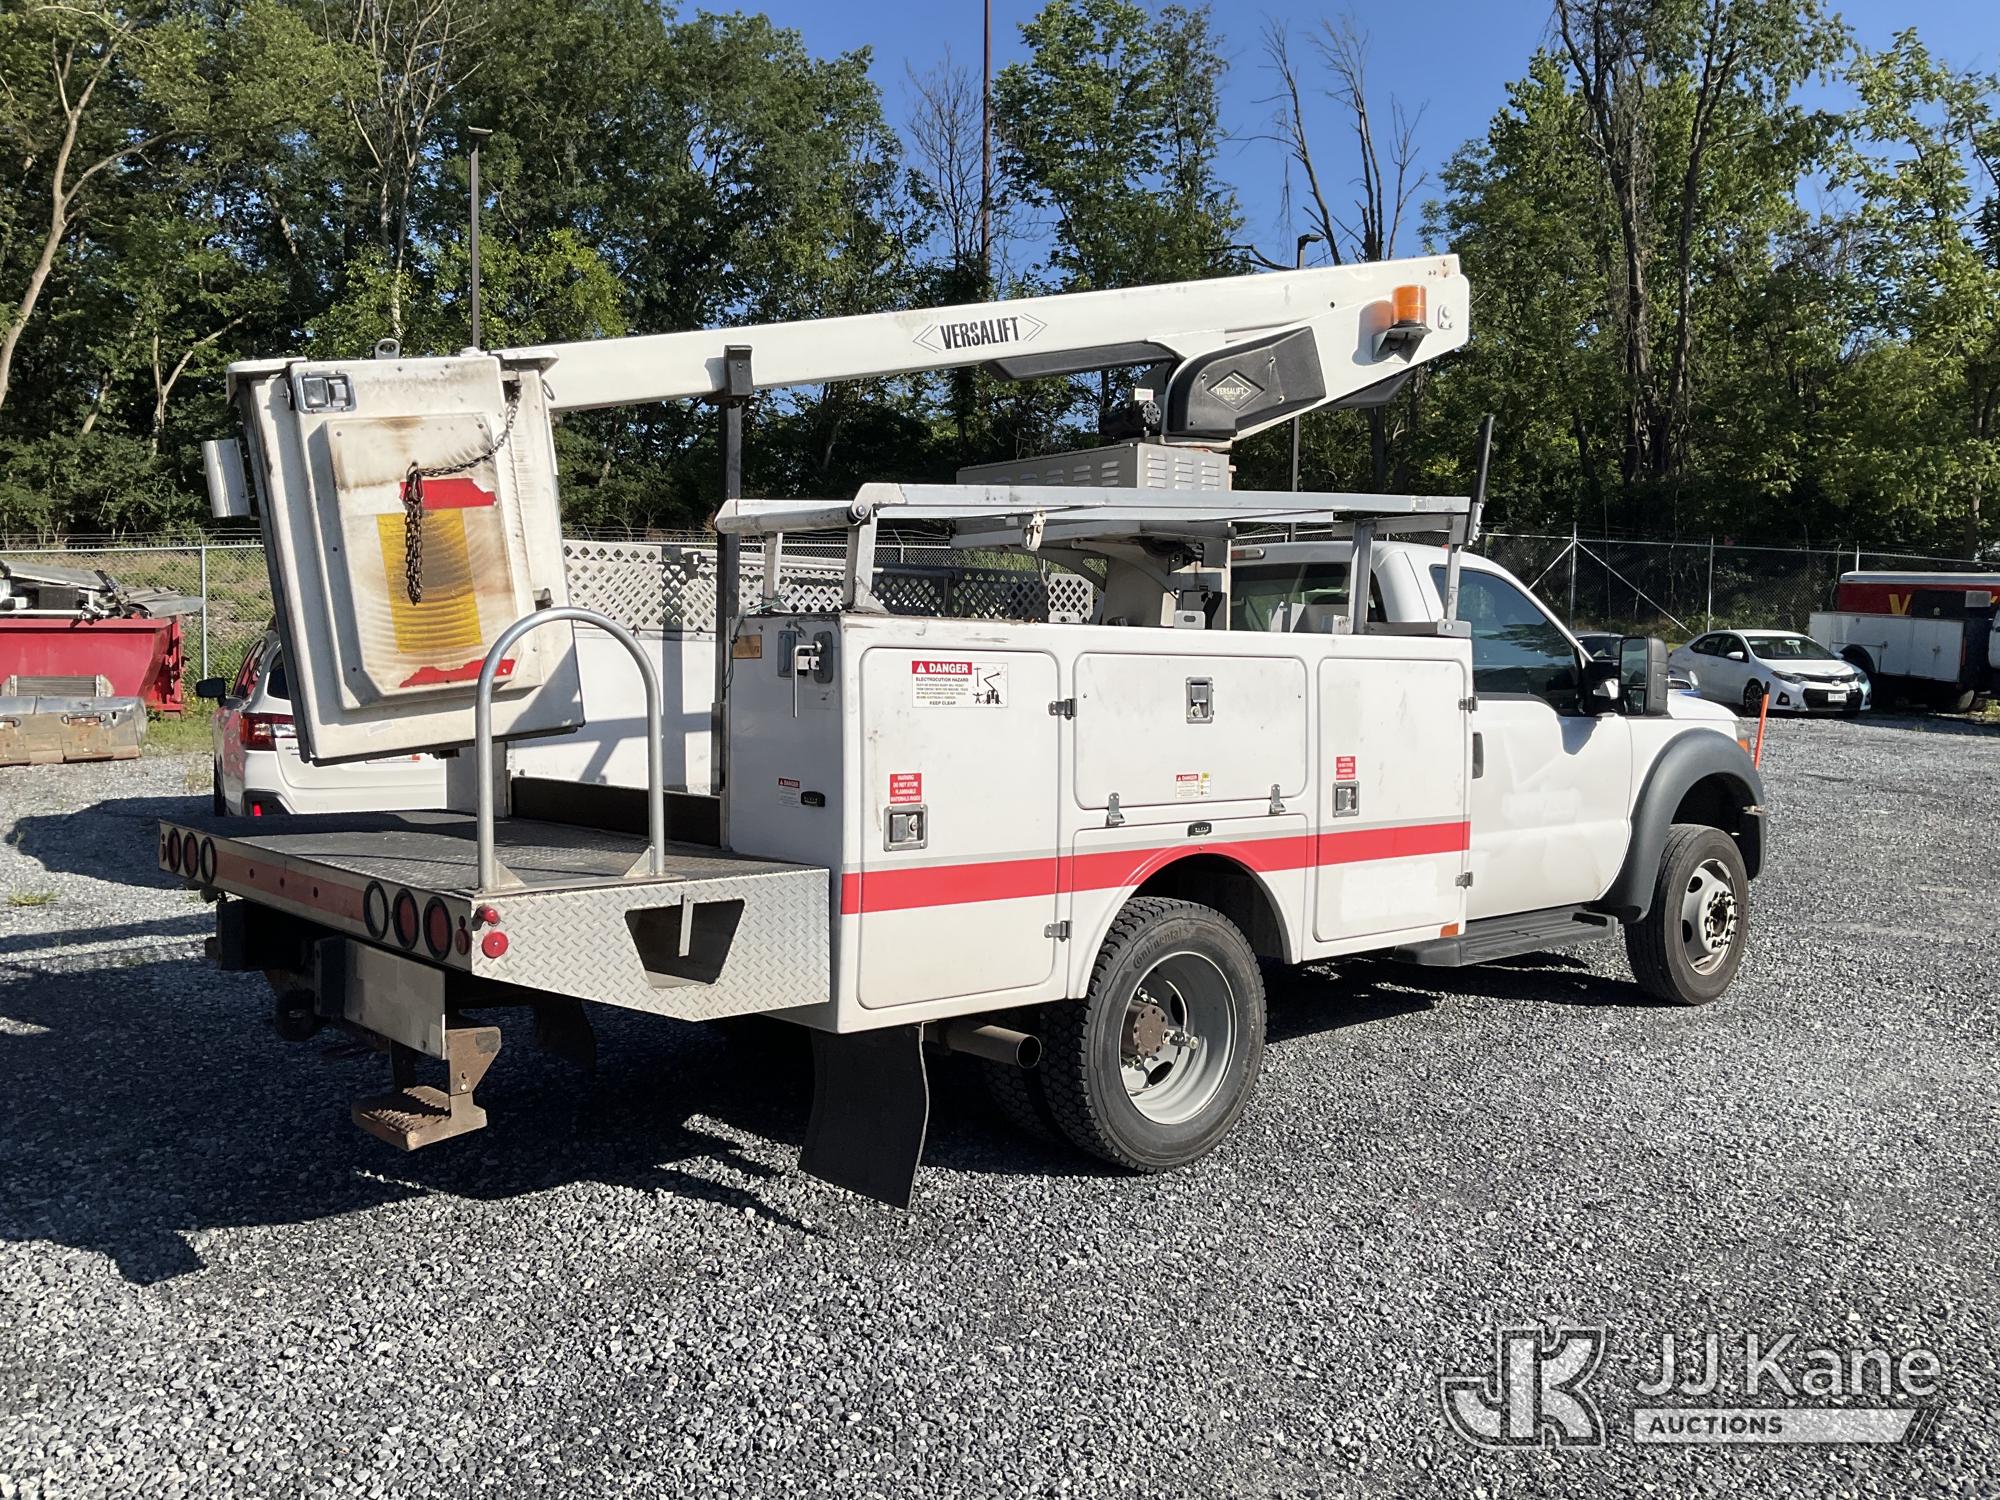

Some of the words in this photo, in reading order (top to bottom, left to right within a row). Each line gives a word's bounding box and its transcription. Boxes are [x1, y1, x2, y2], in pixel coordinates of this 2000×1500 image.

[939, 316, 1020, 350] VERSALIFT
[1215, 386, 1245, 396] VERSALIFT
[929, 663, 969, 673] DANGER
